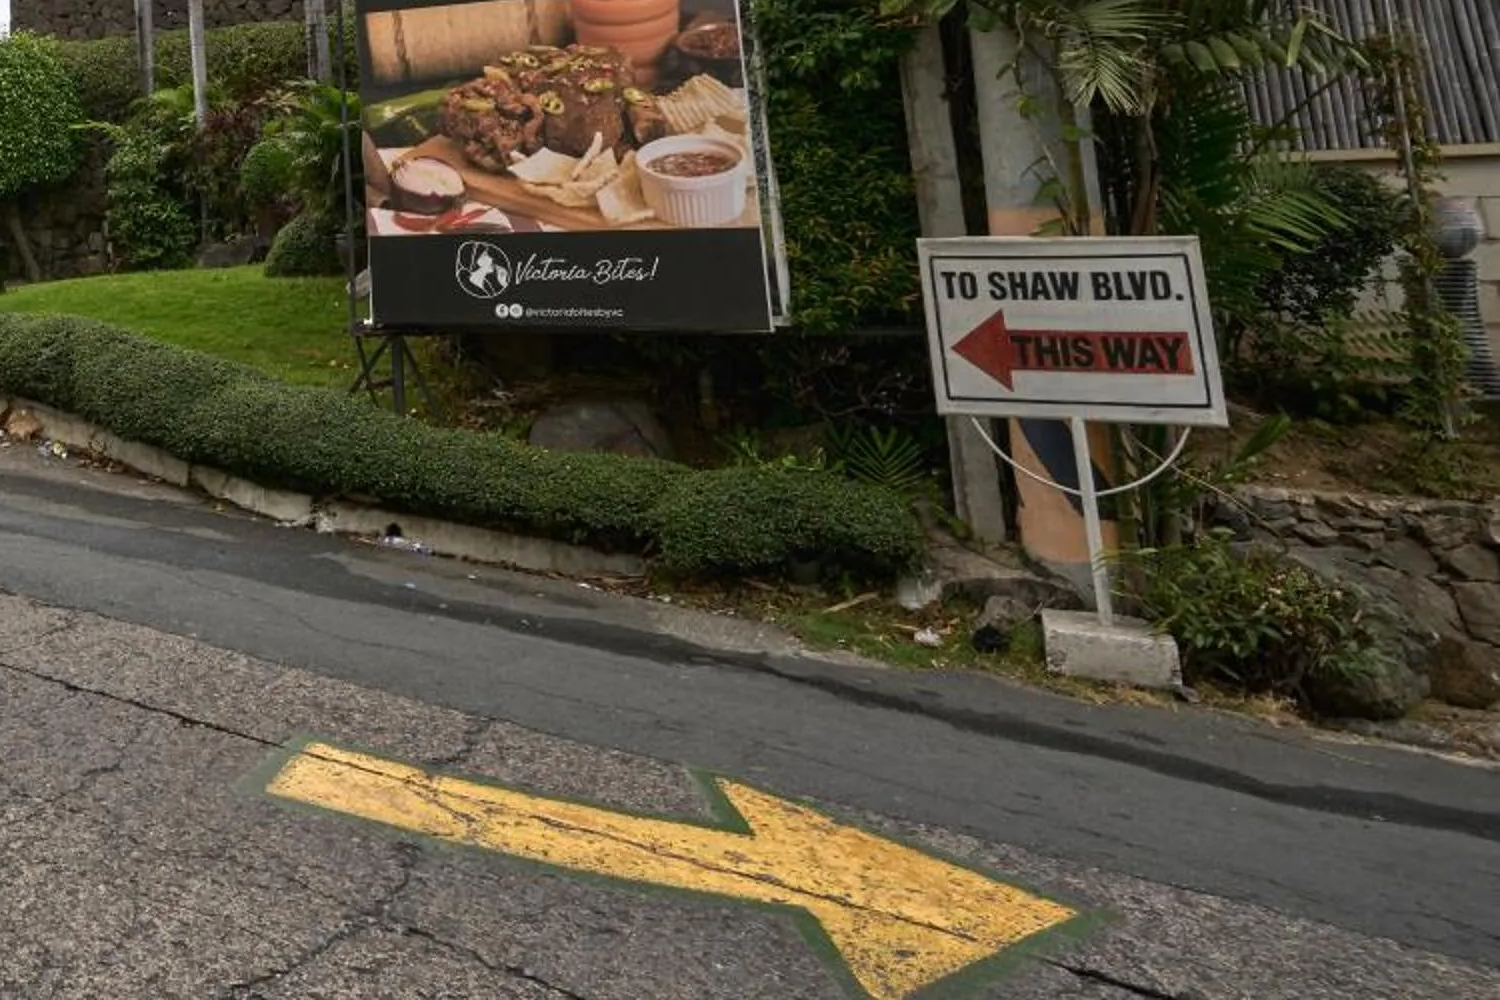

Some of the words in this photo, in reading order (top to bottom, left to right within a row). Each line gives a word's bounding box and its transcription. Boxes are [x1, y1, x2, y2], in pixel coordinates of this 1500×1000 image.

[515, 253, 591, 285] Victoria
[593, 256, 659, 285] Bites!
[940, 271, 978, 299] TO
[989, 271, 1079, 301] SHAW
[1092, 270, 1184, 301] BLVD.
[1009, 335, 1095, 368] THIS
[1102, 336, 1184, 370] WAY
